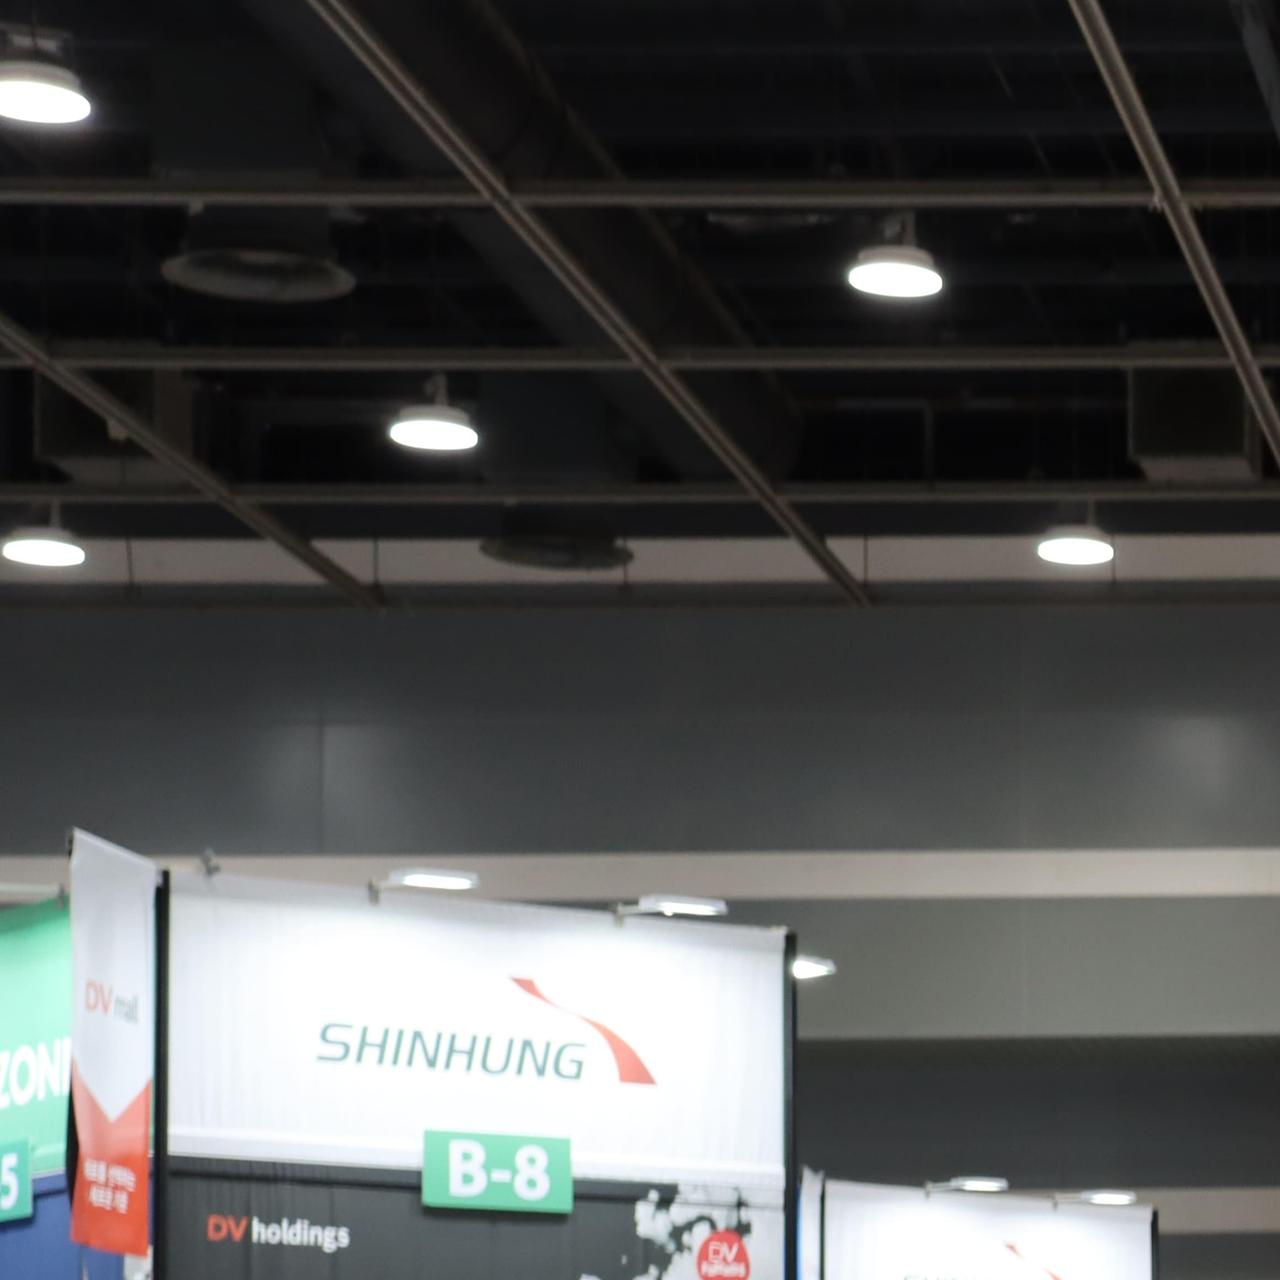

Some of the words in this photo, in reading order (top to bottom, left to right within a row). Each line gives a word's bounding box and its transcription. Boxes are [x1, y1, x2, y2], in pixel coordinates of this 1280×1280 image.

[318, 1022, 587, 1081] SHINHUNG
[448, 1138, 551, 1202] B-8
[206, 1215, 248, 1242] DV
[251, 1216, 351, 1254] holdings
